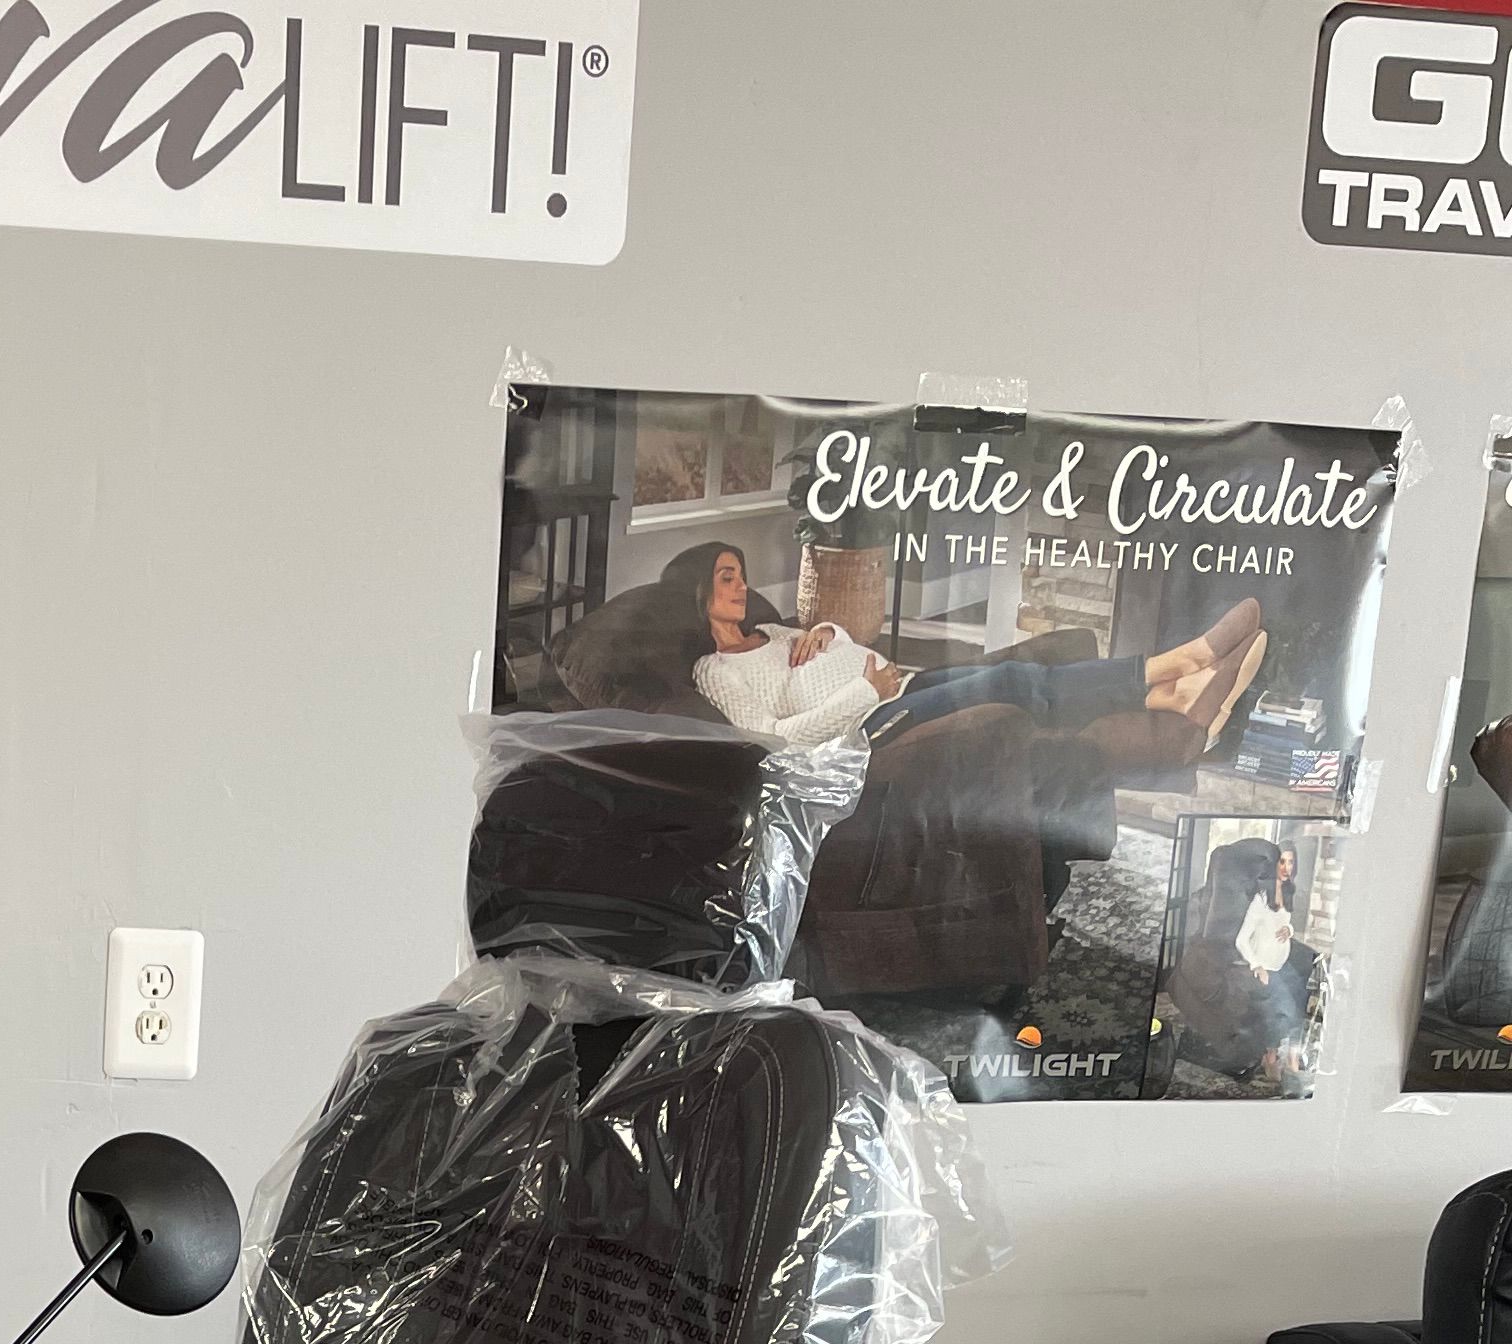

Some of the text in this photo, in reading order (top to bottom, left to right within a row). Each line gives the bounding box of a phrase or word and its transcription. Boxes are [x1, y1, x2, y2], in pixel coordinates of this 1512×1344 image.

[1322, 16, 1512, 168] G
[1318, 169, 1512, 239] TRAV
[807, 430, 1379, 535] Elevate & Circulate
[893, 532, 1295, 576] IN THE HEALTHY CHAIR
[942, 1052, 1123, 1078] TWILIGHT
[646, 1282, 675, 1304] BAG
[685, 1271, 741, 1302] DISPOSAL
[548, 1294, 576, 1315] BAG
[682, 1296, 709, 1316] THIS
[586, 1309, 615, 1330] THIS
[624, 1323, 649, 1344] USE
